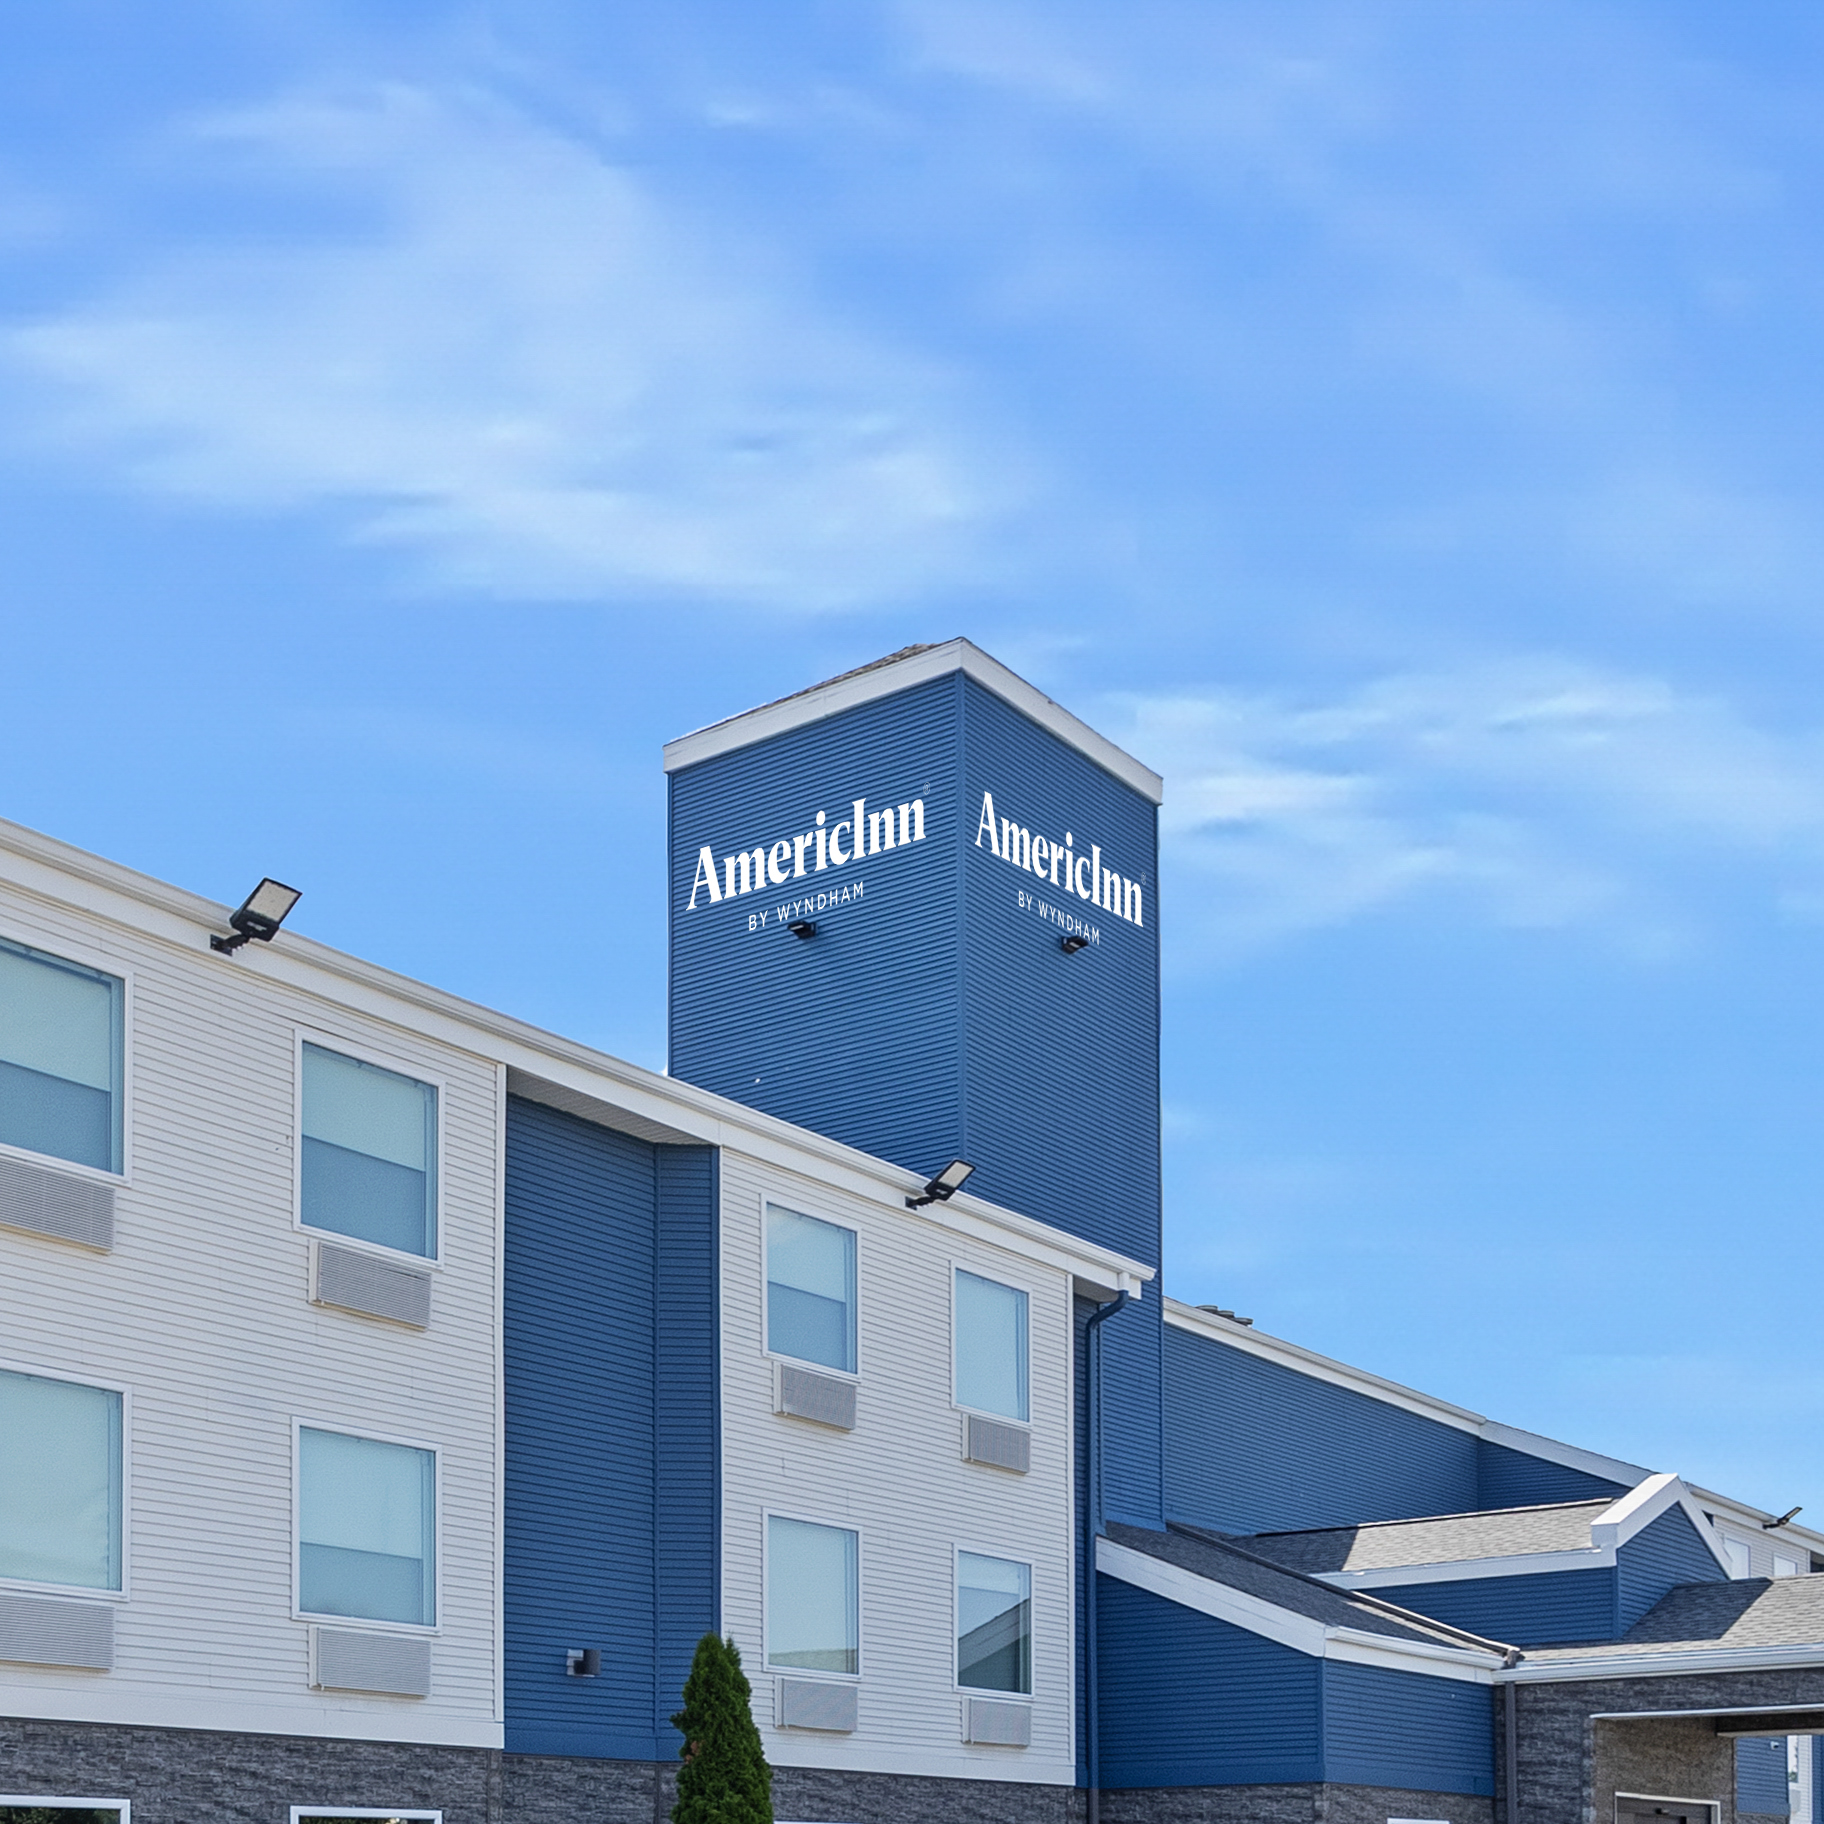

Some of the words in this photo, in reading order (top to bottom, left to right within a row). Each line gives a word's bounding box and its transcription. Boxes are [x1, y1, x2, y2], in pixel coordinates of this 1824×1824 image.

[686, 798, 926, 911] AmericInn
[975, 791, 1143, 927] AmericInn
[748, 910, 769, 931] BY
[777, 881, 864, 922] WYNDHAM
[1018, 890, 1033, 911] BY
[1038, 900, 1100, 945] WYNDHAM
